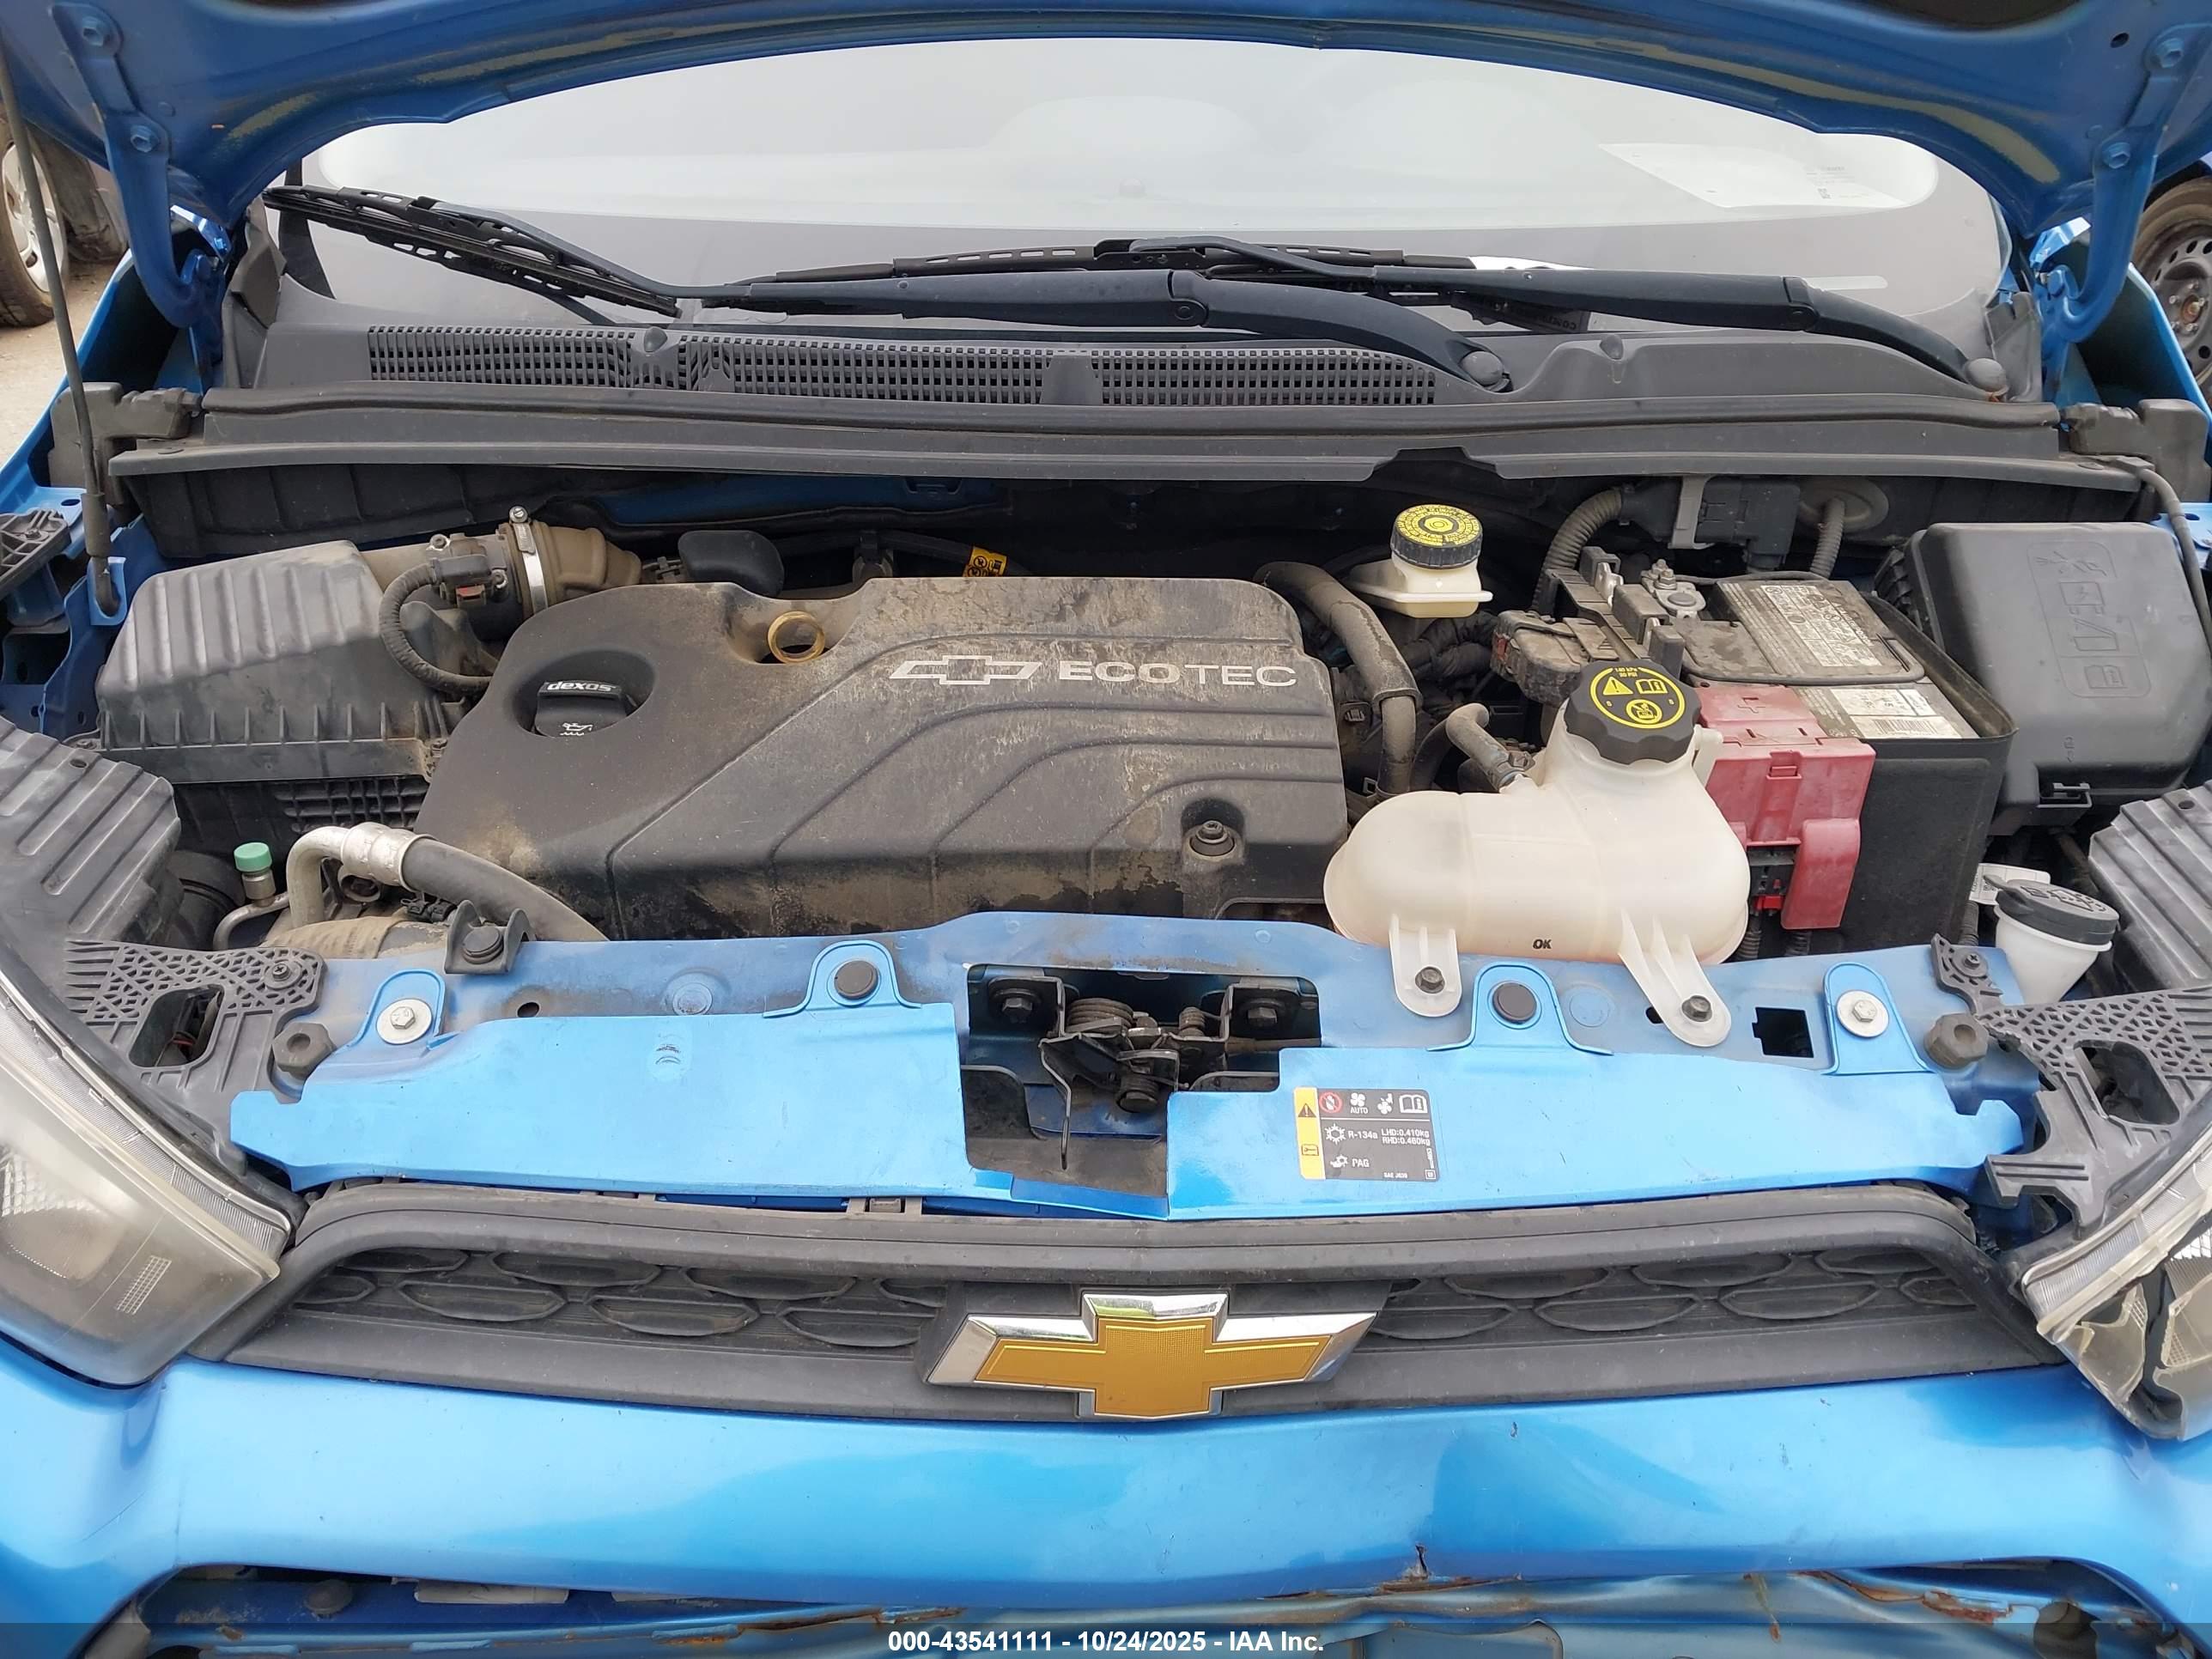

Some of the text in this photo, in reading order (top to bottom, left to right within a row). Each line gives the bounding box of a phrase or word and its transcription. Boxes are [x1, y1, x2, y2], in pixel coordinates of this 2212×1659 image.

[1059, 660, 1297, 687] ECOTEC
[547, 681, 613, 692] dexos
[1533, 939, 1552, 949] OK
[1348, 1130, 1378, 1139] R-134a
[1352, 1158, 1370, 1168] PAG
